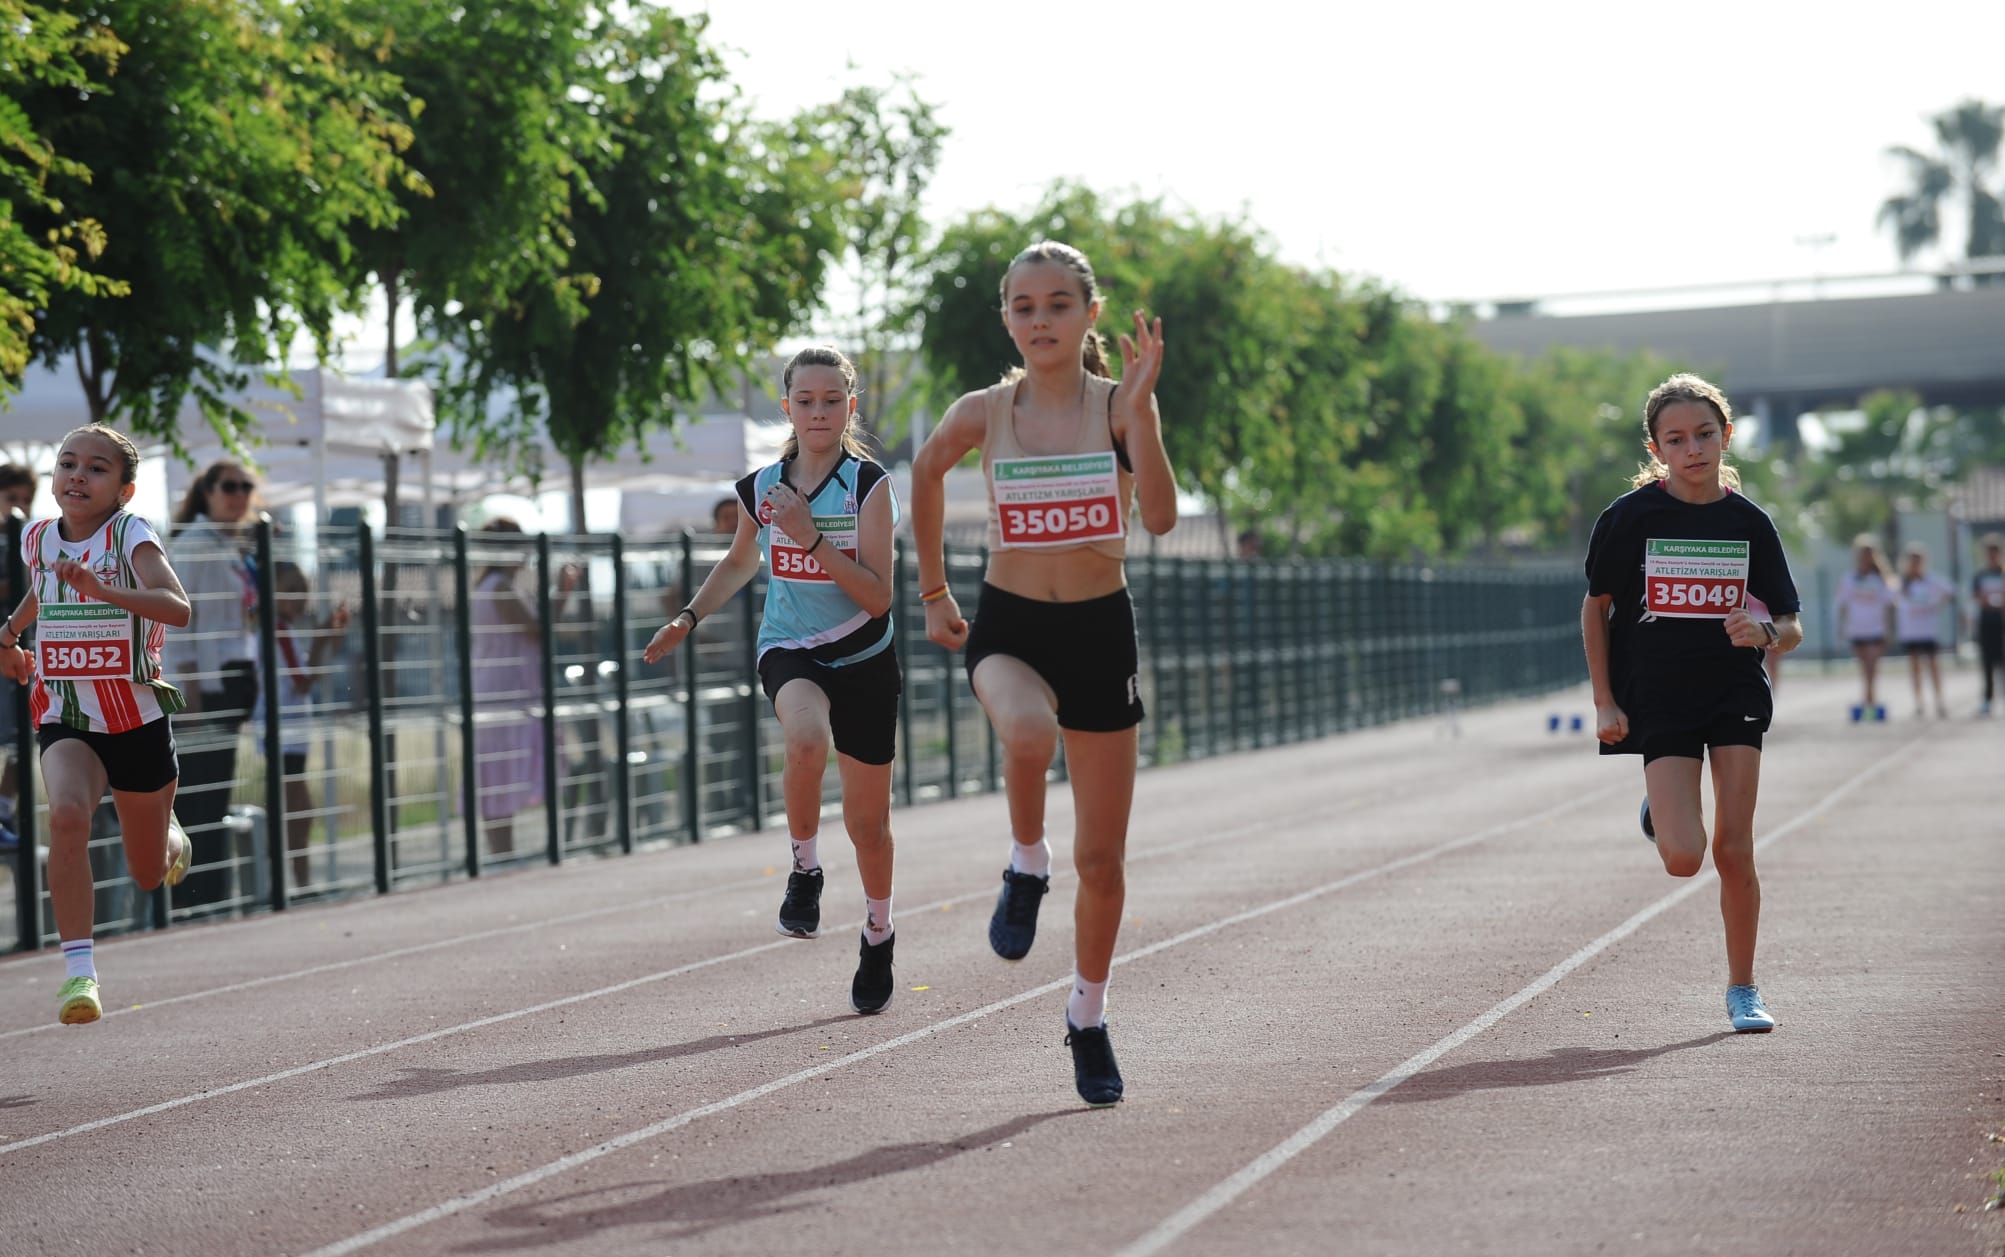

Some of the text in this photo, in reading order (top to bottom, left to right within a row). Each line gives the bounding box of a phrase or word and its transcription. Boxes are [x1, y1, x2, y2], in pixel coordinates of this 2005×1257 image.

[1005, 487, 1106, 501] ATLETİZM YARIŞLARI
[1007, 503, 1110, 535] 35050
[1664, 545, 1746, 554] KARŞIYAKA BELEDİYES
[778, 551, 828, 574] 350
[1655, 566, 1740, 577] ATLETİZM YARIŞLARI
[1654, 582, 1739, 607] 35049
[49, 609, 83, 618] KARŞIYAKA
[45, 630, 120, 639] ATLETİZM YARIŞLARI
[46, 646, 122, 669] 35052
